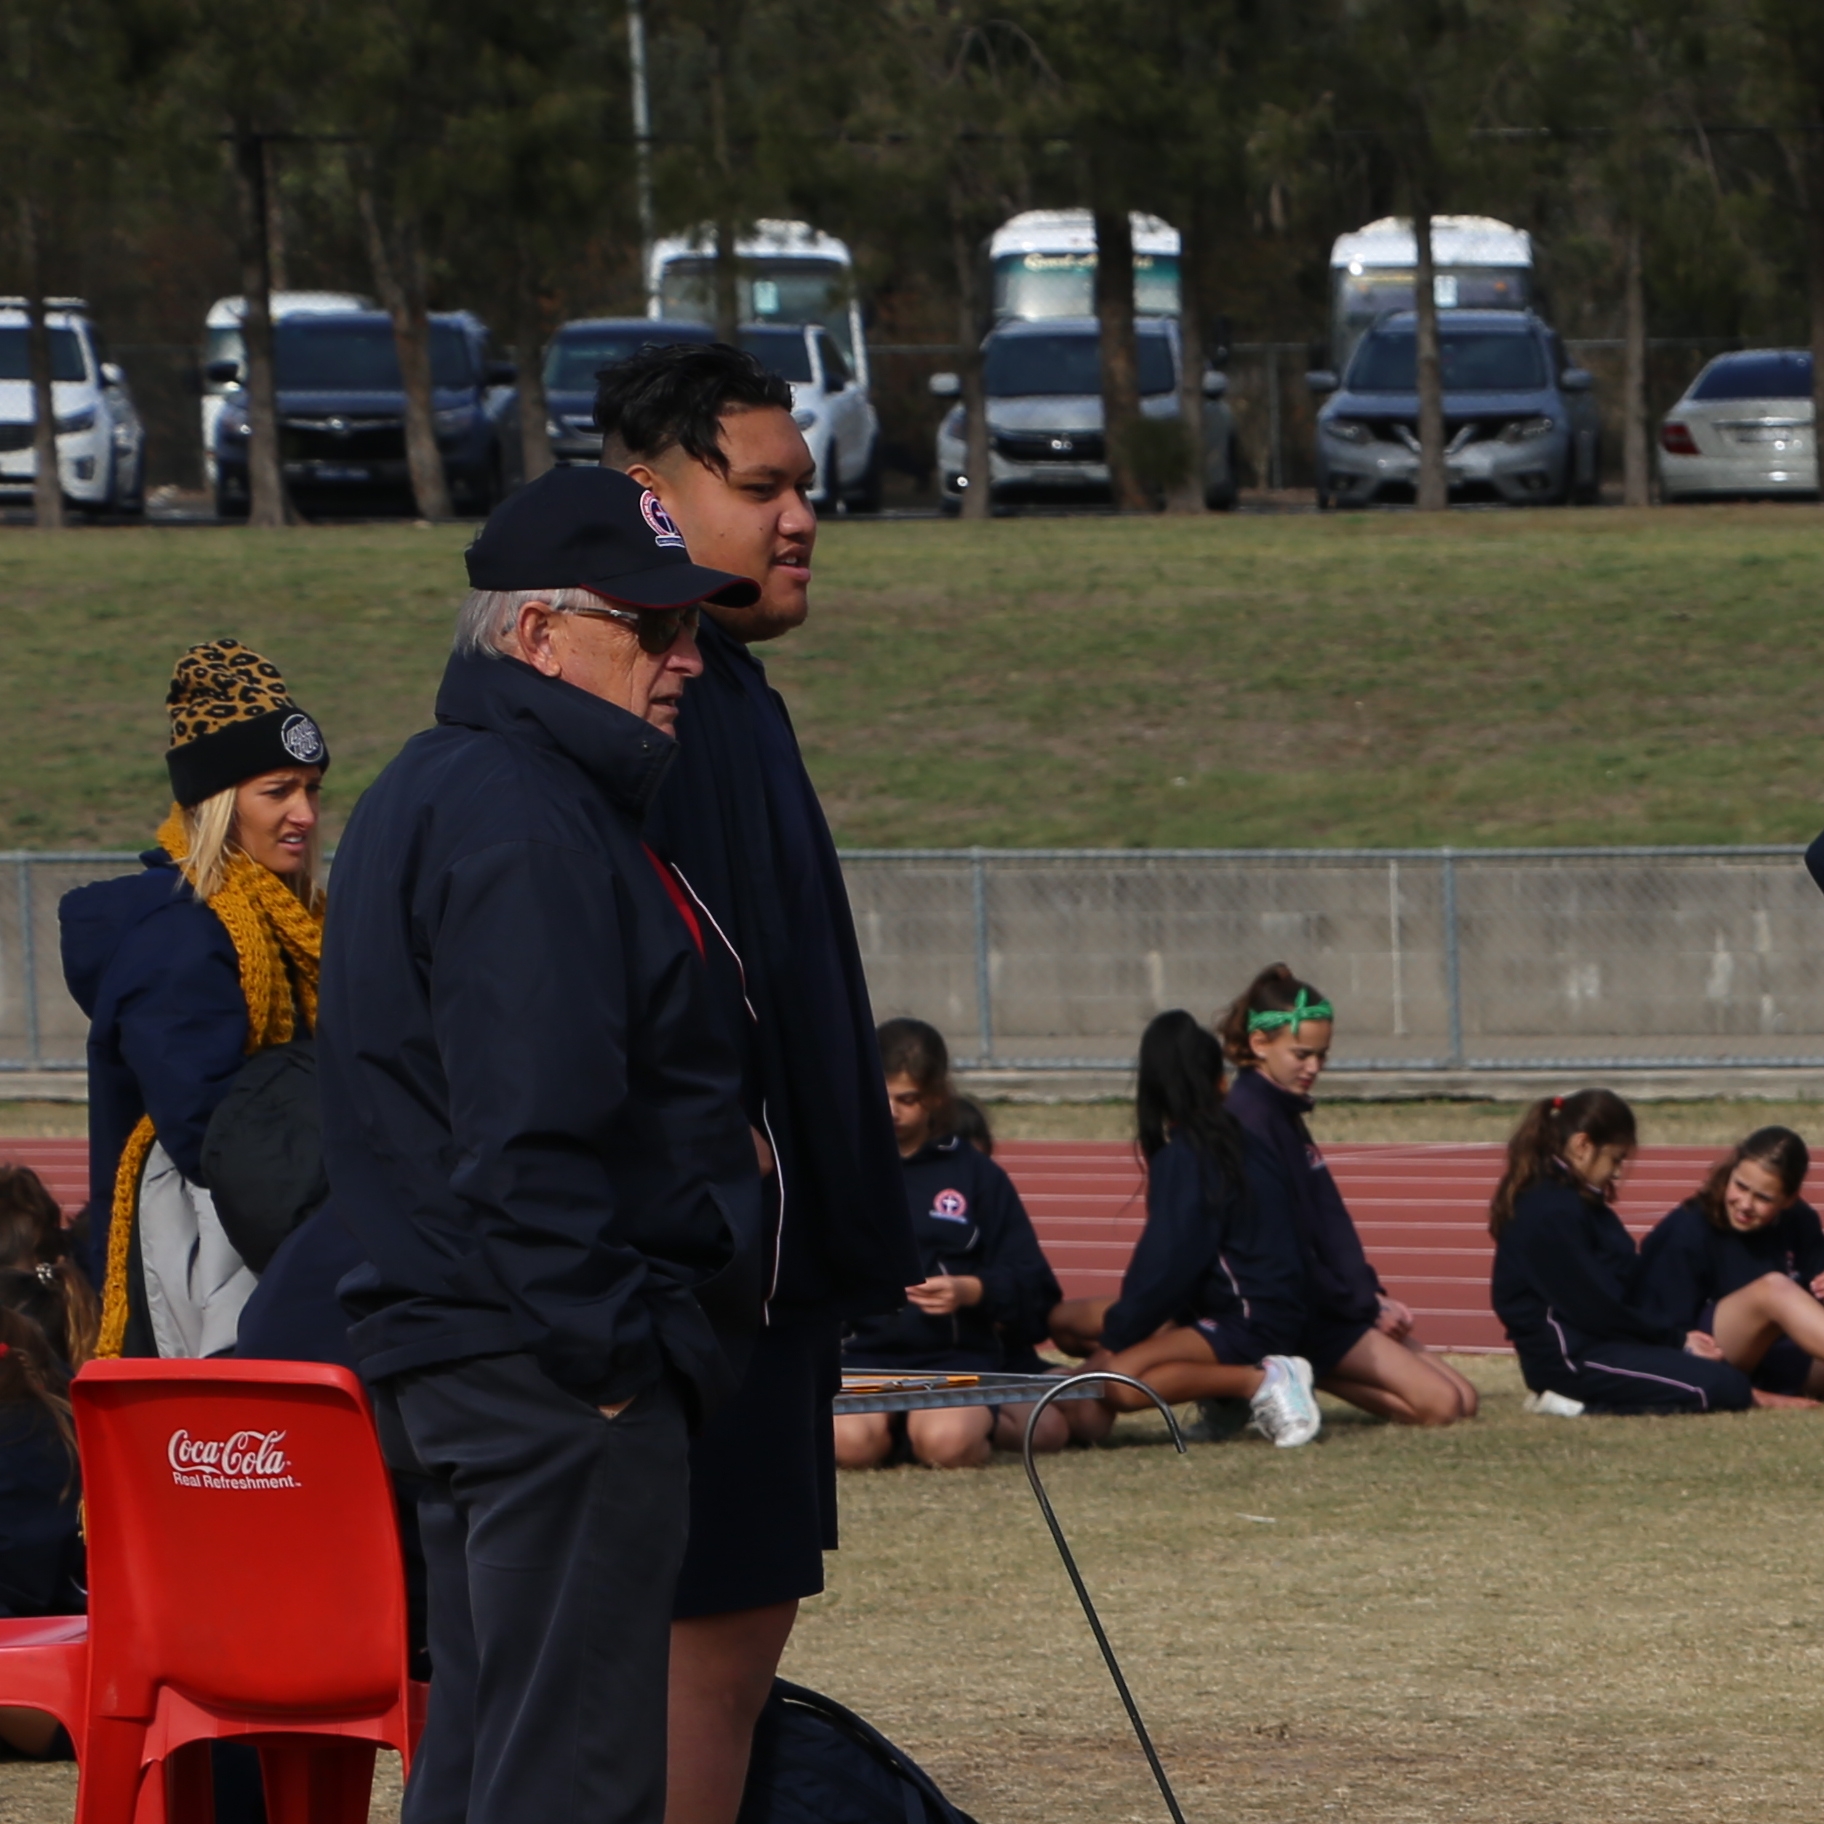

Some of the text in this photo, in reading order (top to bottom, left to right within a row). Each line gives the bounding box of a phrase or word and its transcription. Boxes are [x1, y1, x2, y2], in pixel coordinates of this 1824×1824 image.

[168, 1429, 286, 1475] Coca-Cola
[172, 1471, 295, 1490] Real Refreshment
